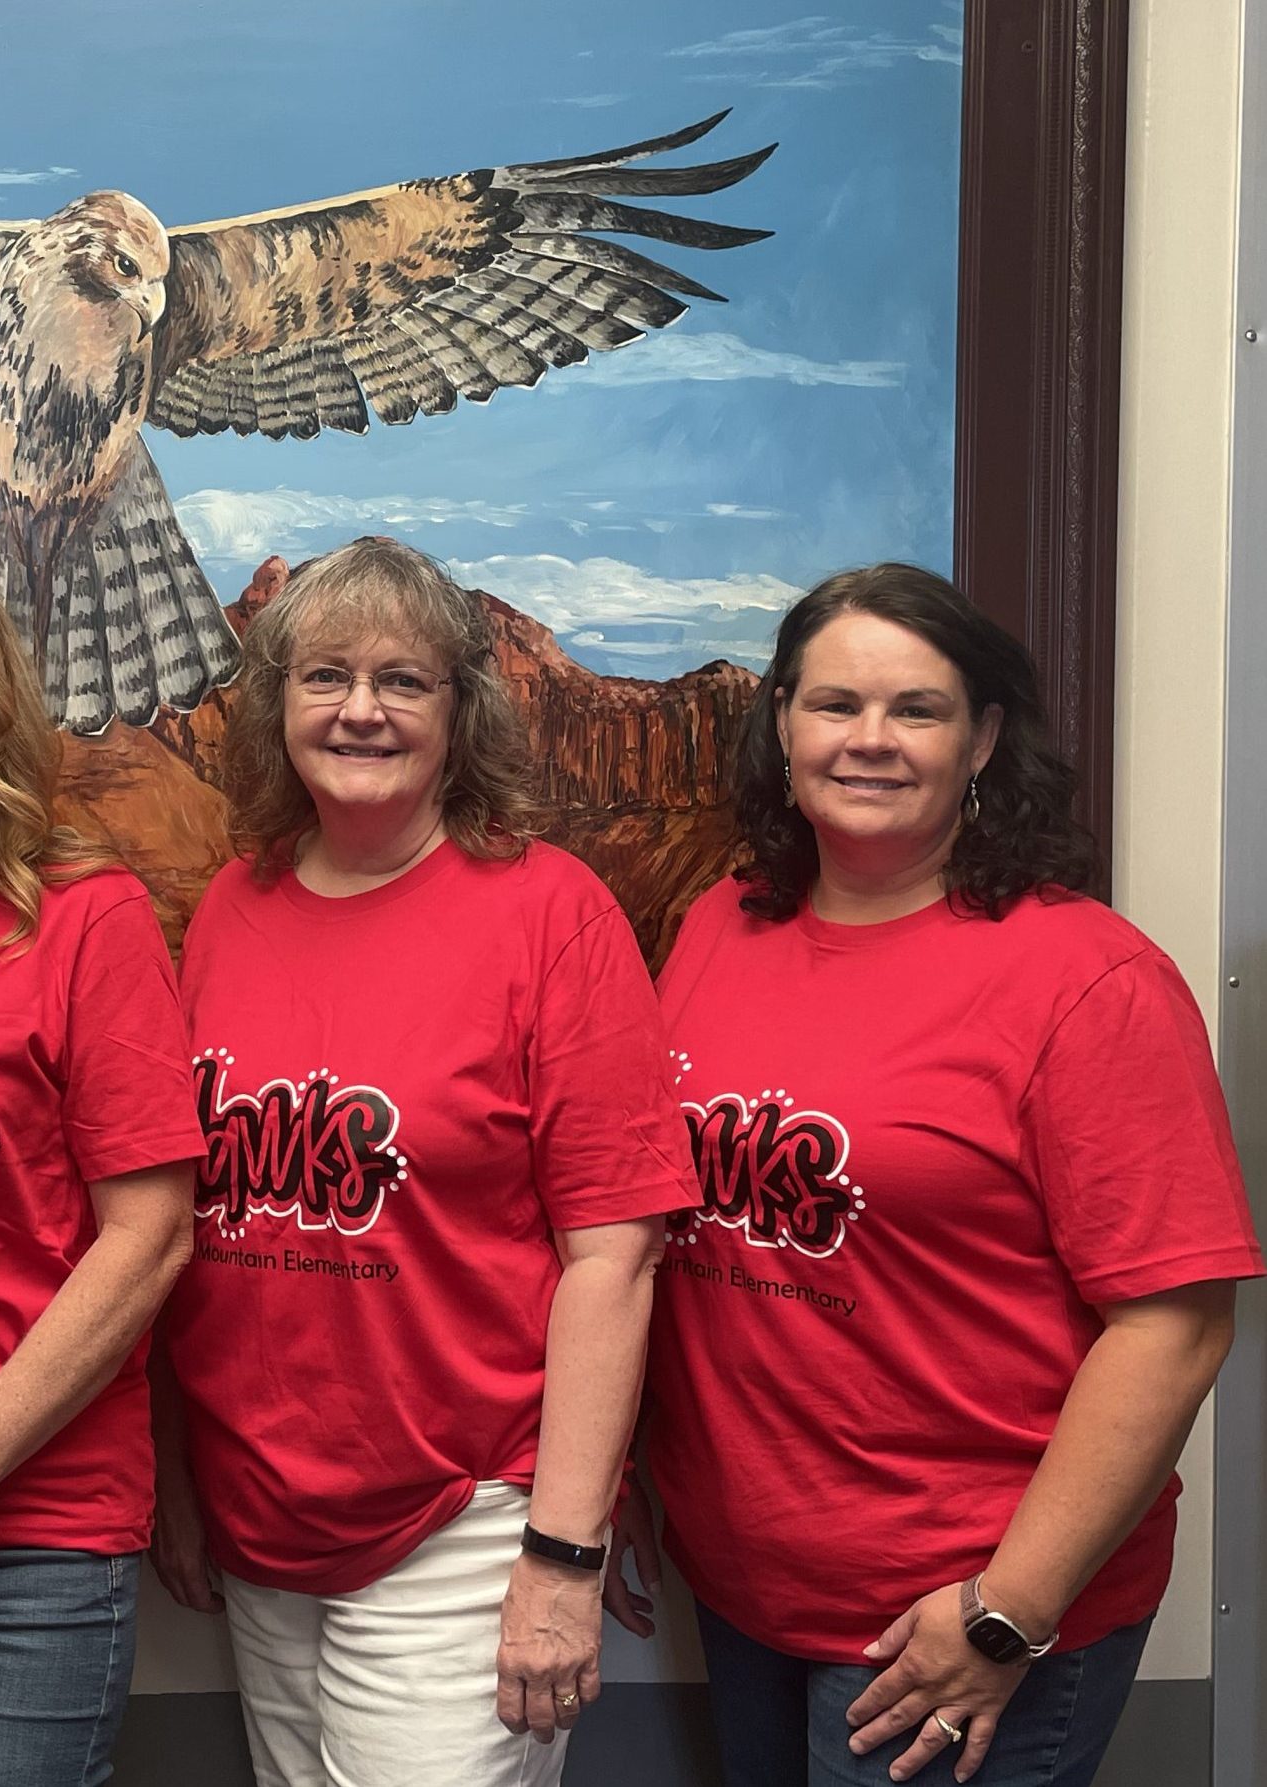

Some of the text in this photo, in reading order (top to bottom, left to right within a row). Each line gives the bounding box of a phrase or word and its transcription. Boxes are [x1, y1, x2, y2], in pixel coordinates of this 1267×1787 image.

[197, 1242, 399, 1282] Mountain Elementary
[730, 1265, 858, 1317] Elementary
